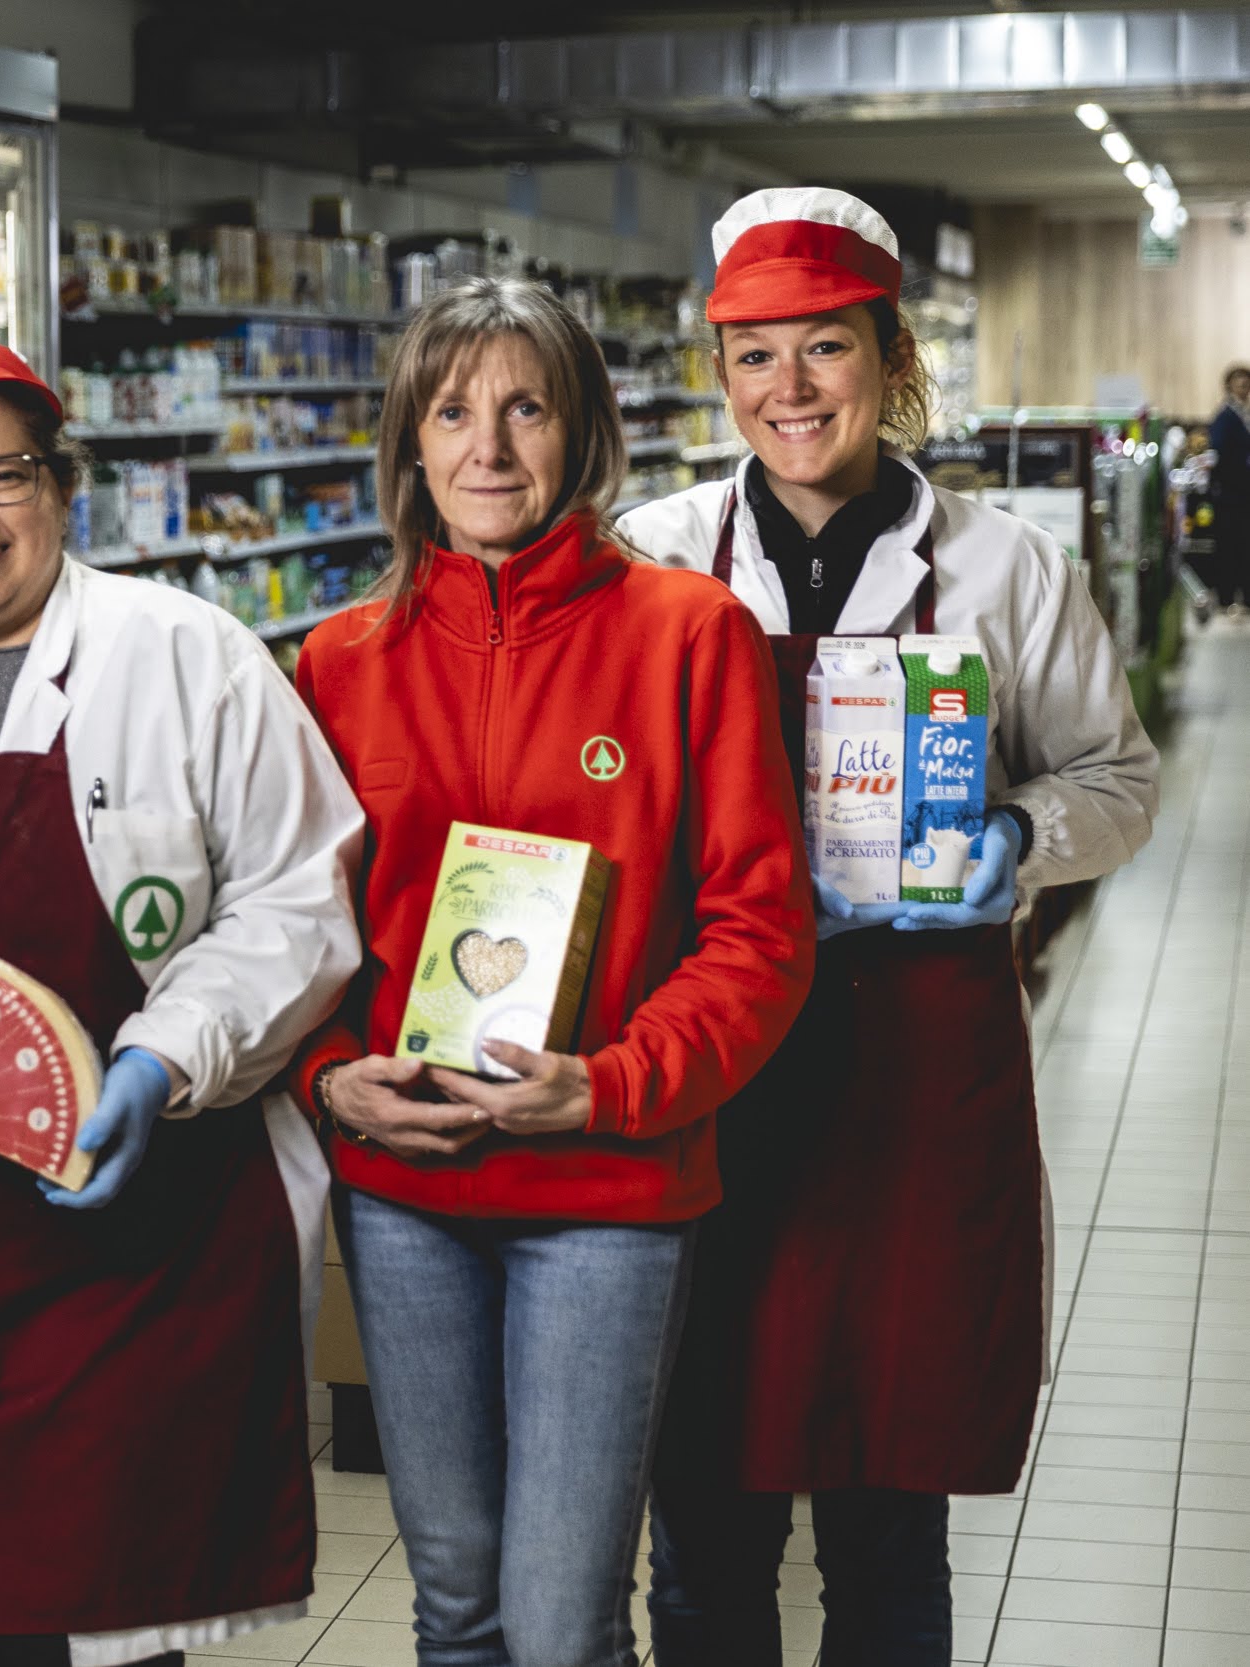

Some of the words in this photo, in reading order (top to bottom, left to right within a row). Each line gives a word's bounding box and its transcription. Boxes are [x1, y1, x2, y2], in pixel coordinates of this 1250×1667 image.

[840, 698, 886, 706] DESPAR
[919, 726, 973, 756] Fior
[831, 739, 896, 780] Latte
[828, 772, 897, 795] PIÙ
[925, 786, 944, 796] LATTE
[945, 786, 968, 796] INTERO
[477, 836, 550, 858] DESPAR
[825, 839, 896, 848] PARZIALMENTE
[825, 848, 896, 858] SCREMATO
